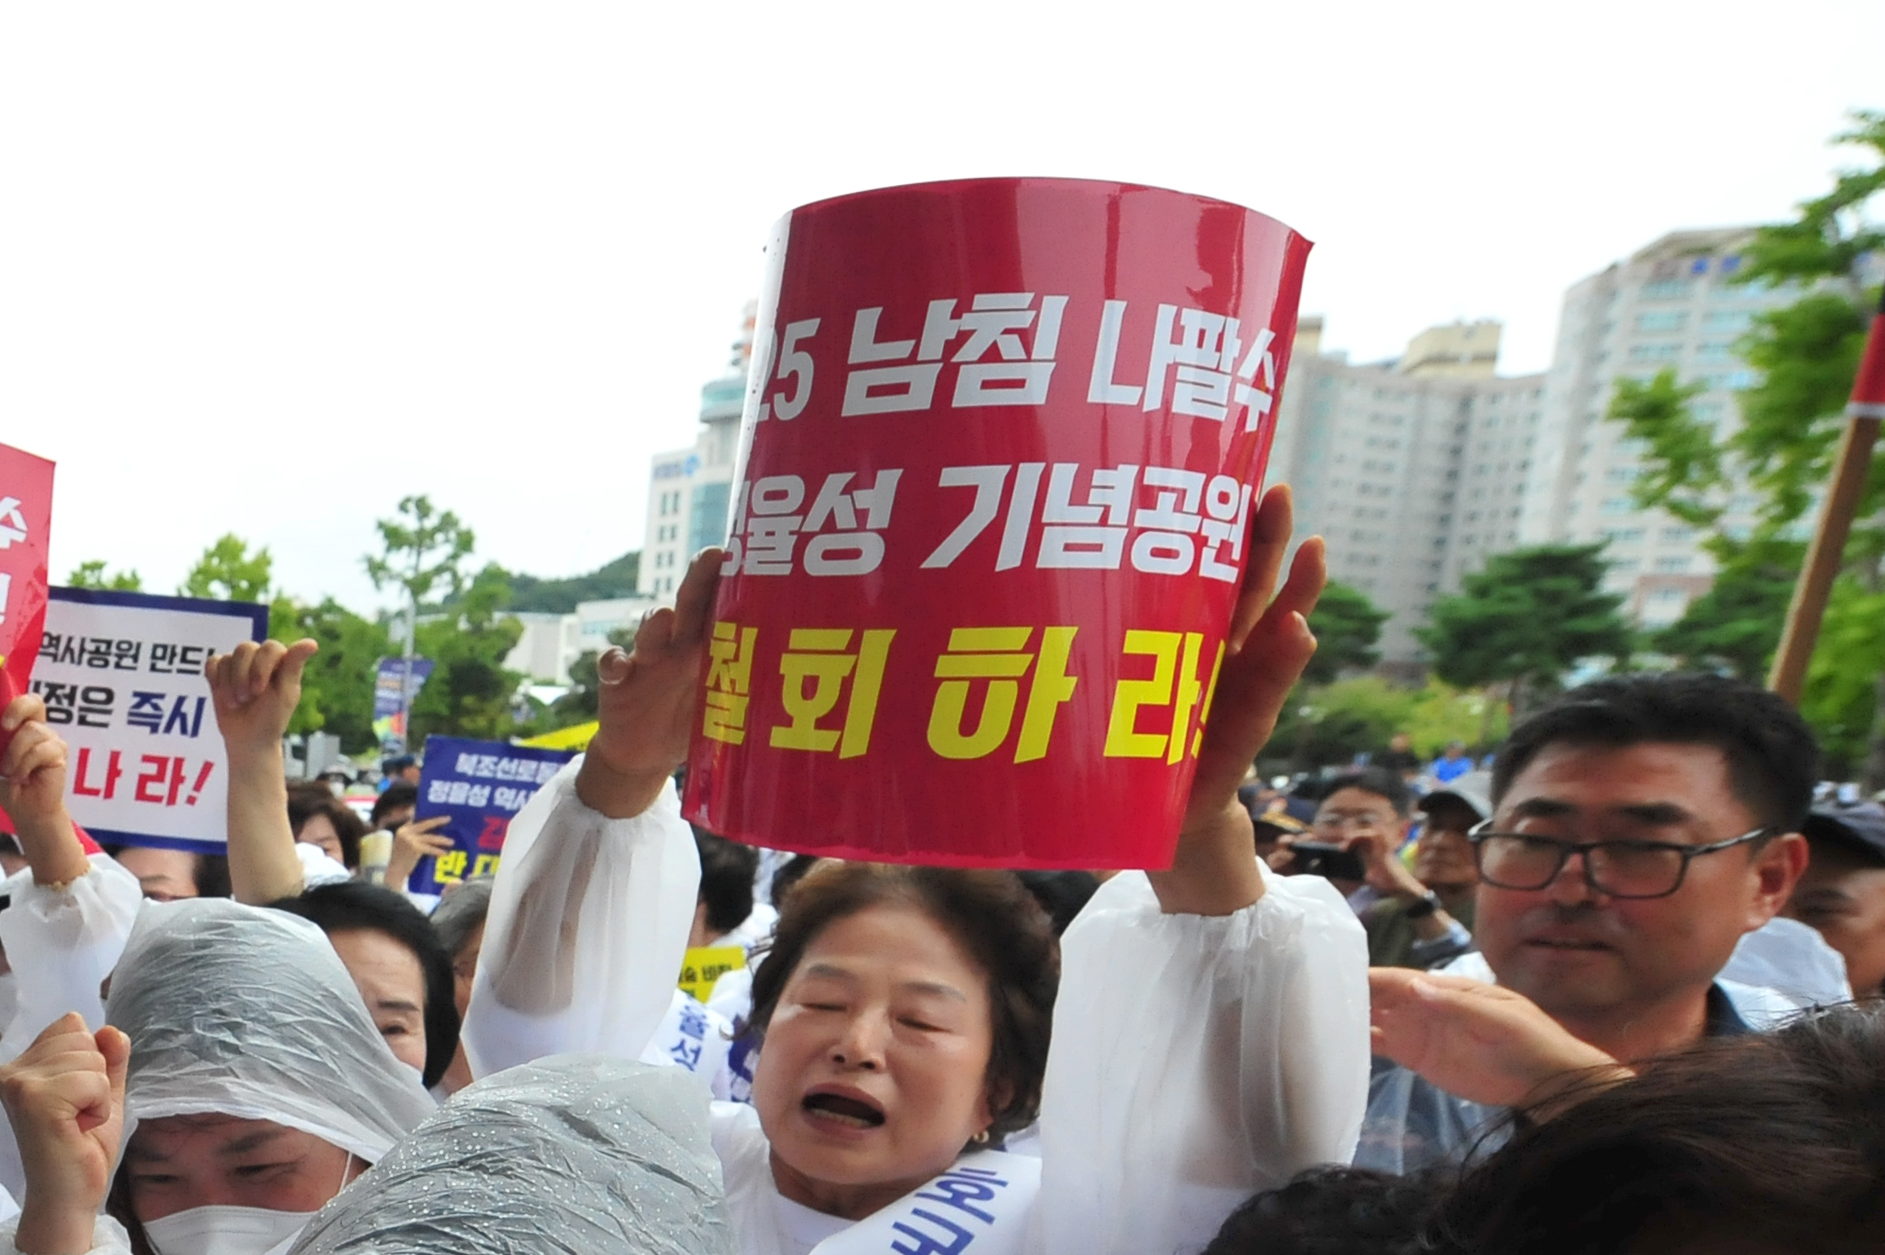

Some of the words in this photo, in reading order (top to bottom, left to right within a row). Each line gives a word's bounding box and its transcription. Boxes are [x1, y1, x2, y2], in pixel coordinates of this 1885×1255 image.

[841, 292, 1069, 417] 남침
[1087, 298, 1276, 433] 나팔수
[919, 462, 1253, 584] 기념공원
[39, 631, 142, 671] 역사공원
[149, 641, 215, 676] 만드
[126, 690, 207, 738] 즉시
